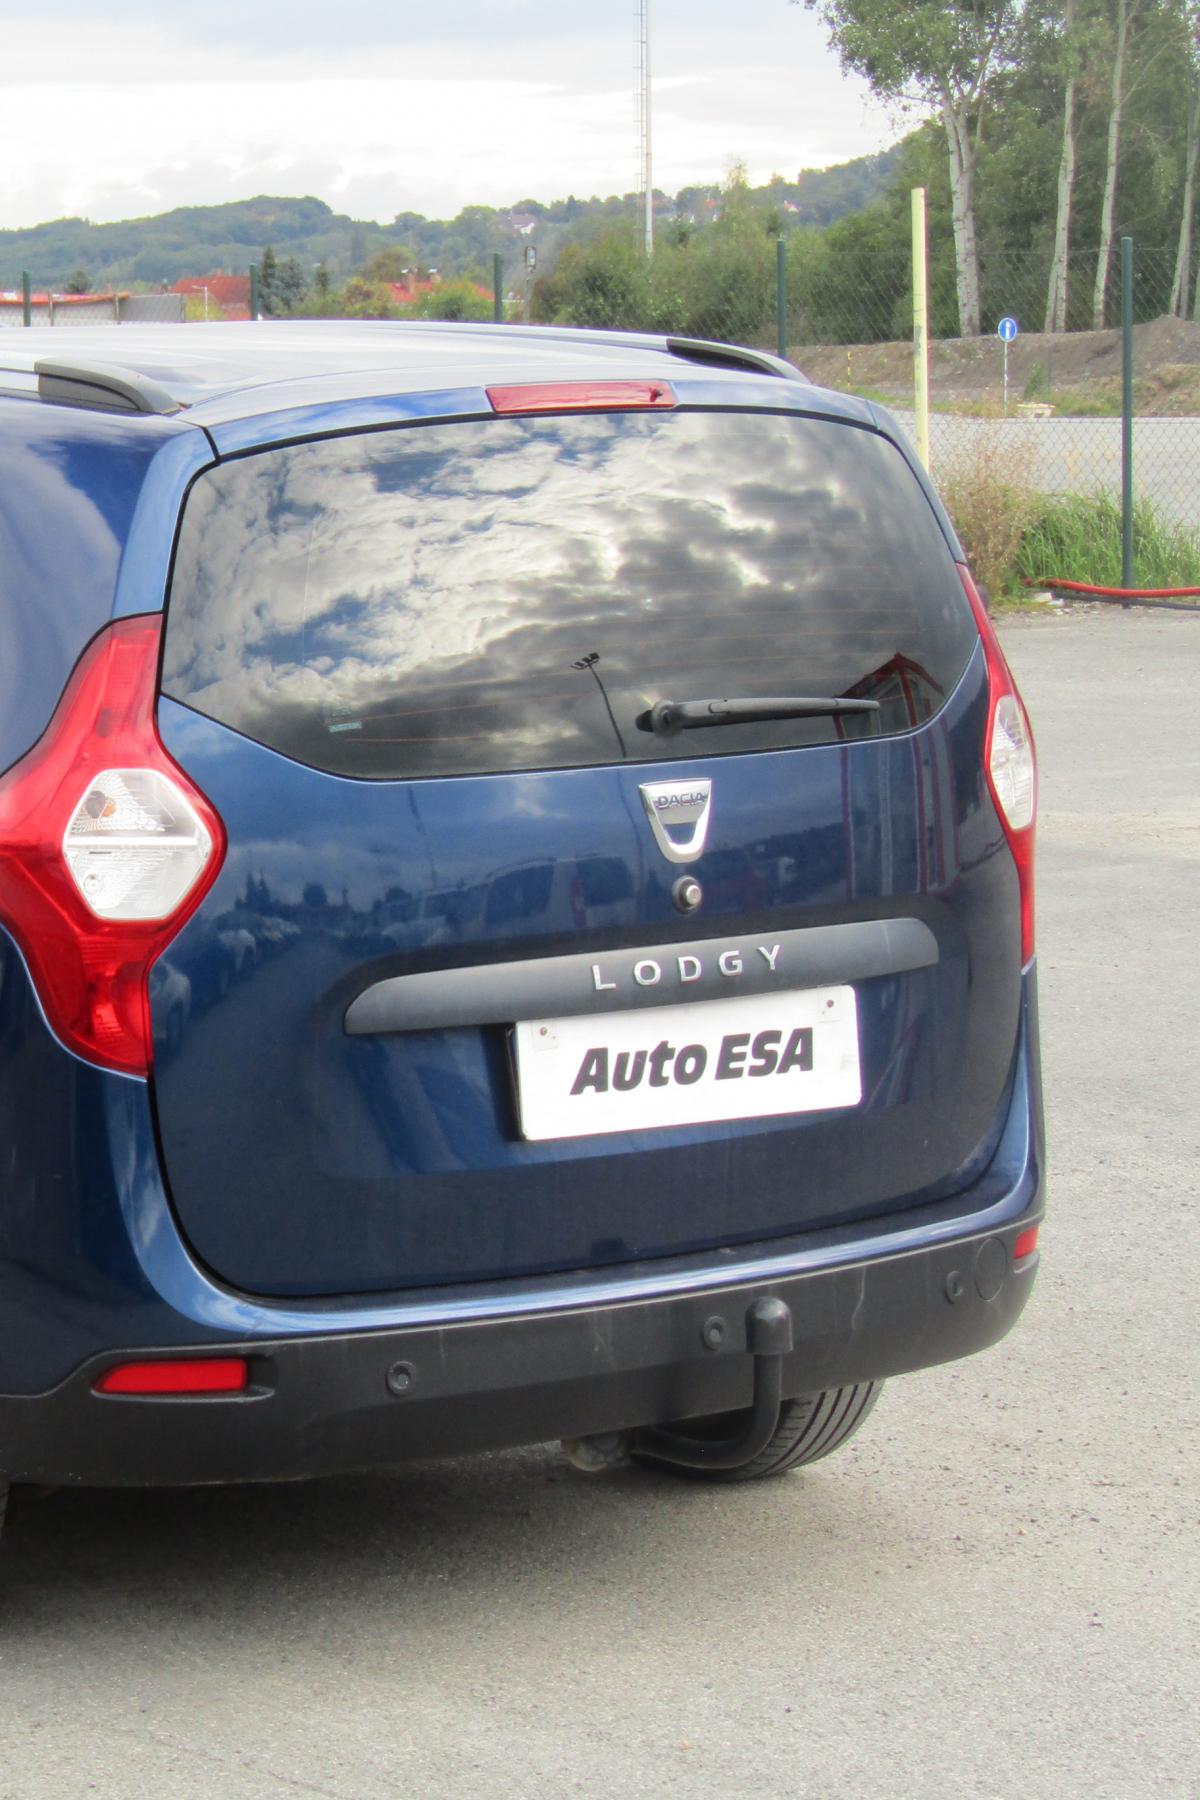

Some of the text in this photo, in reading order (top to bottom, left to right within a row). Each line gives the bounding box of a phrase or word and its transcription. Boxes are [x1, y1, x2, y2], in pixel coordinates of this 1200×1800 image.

[657, 792, 705, 808] DACIA
[591, 944, 781, 991] LODGY
[569, 1027, 814, 1096] Auto ESA
